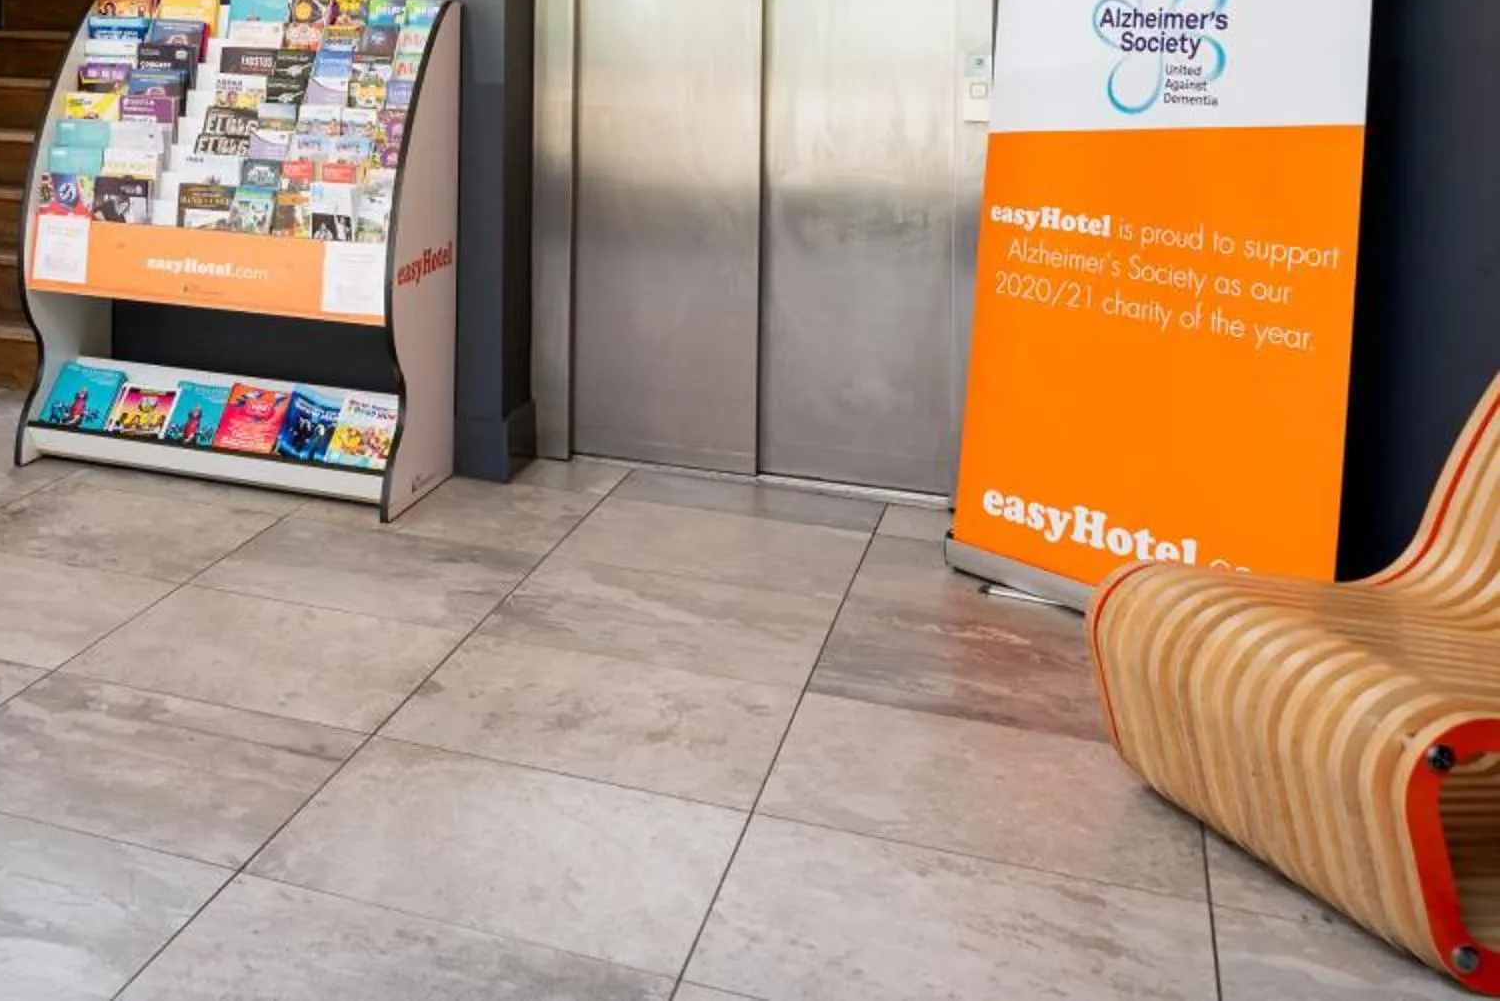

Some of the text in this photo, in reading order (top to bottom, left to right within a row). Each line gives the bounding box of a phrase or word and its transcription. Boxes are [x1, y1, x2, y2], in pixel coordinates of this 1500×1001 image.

[1100, 7, 1228, 30] Alzheimer's
[1120, 30, 1201, 59] Society
[1165, 64, 1202, 76] United
[1164, 77, 1208, 93] Against
[1163, 93, 1219, 107] Dementia
[990, 204, 1340, 272] easyHotel is proud to support
[147, 257, 268, 281] easyHotel.com
[397, 241, 453, 287] easyHotel
[1007, 237, 1292, 305] Alzheimer's Society as our
[994, 270, 1315, 352] 2020/21 charity of the year.
